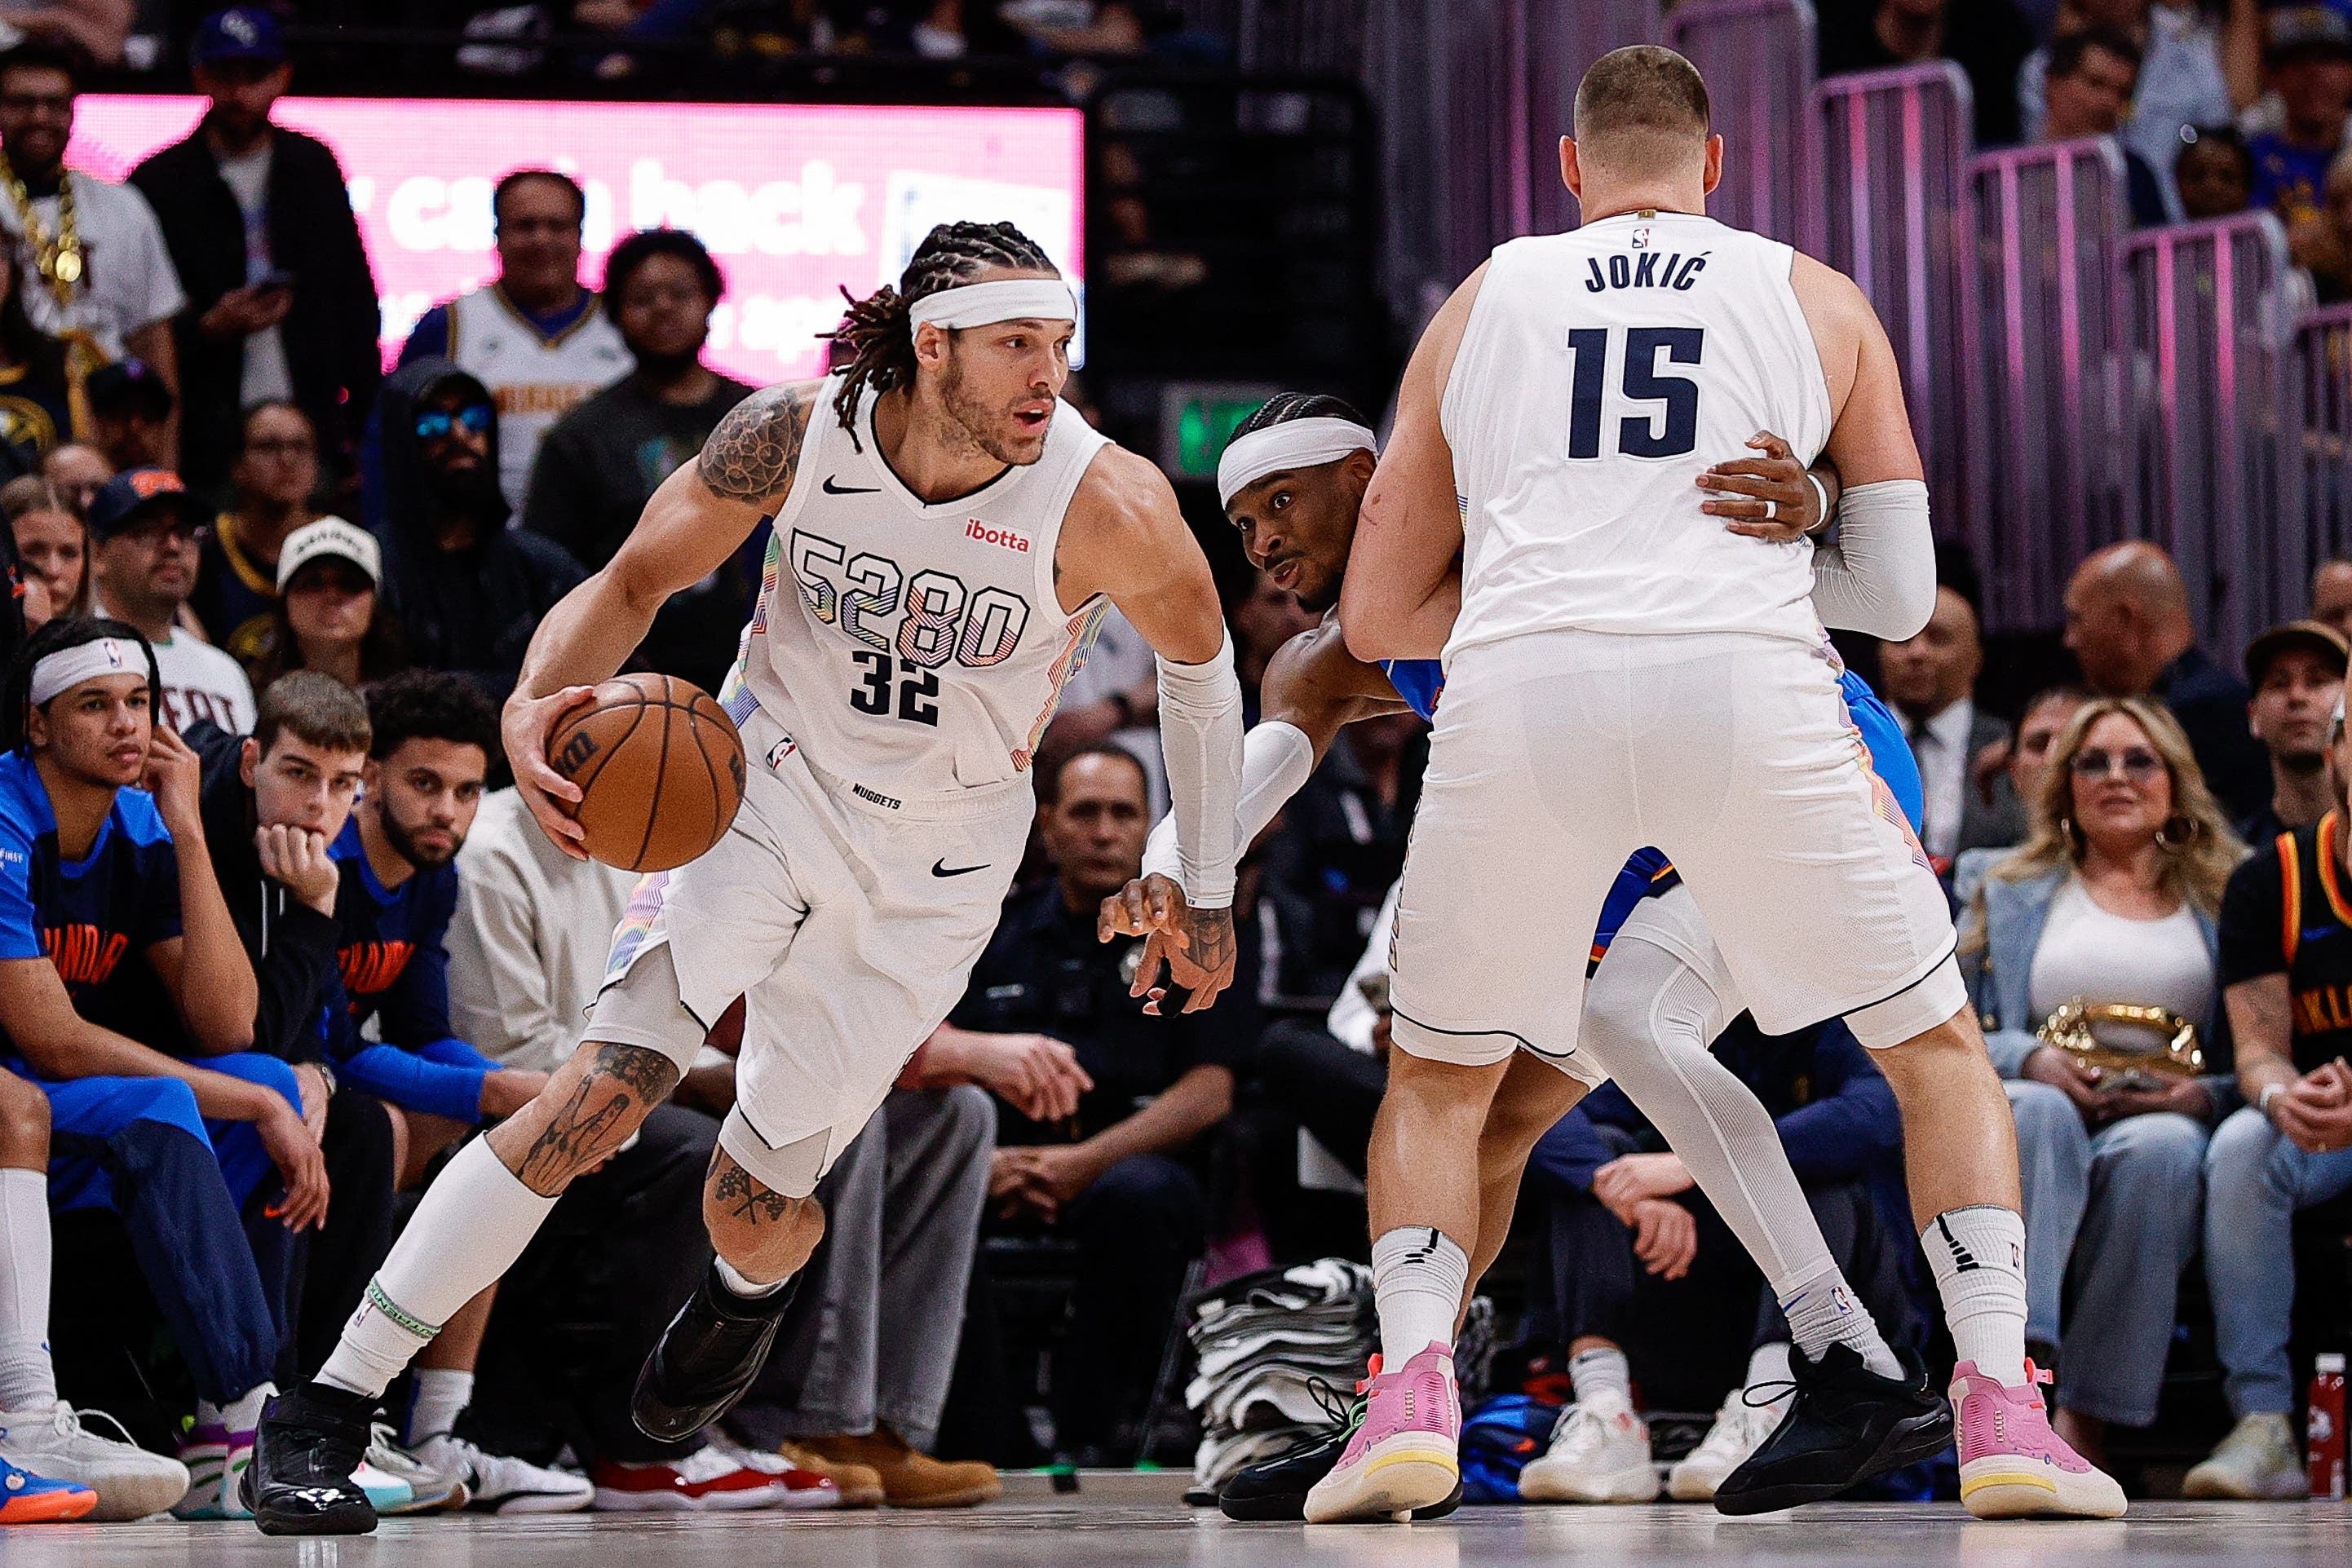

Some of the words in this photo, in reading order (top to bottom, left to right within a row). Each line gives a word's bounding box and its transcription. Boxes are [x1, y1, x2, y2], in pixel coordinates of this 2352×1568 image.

[1585, 250, 1712, 293] JOKIĆ
[1567, 327, 1704, 459] 15
[965, 518, 1029, 553] ibotta
[789, 527, 1031, 670] 5280
[850, 651, 939, 727] 32
[852, 783, 902, 810] NUGGETS
